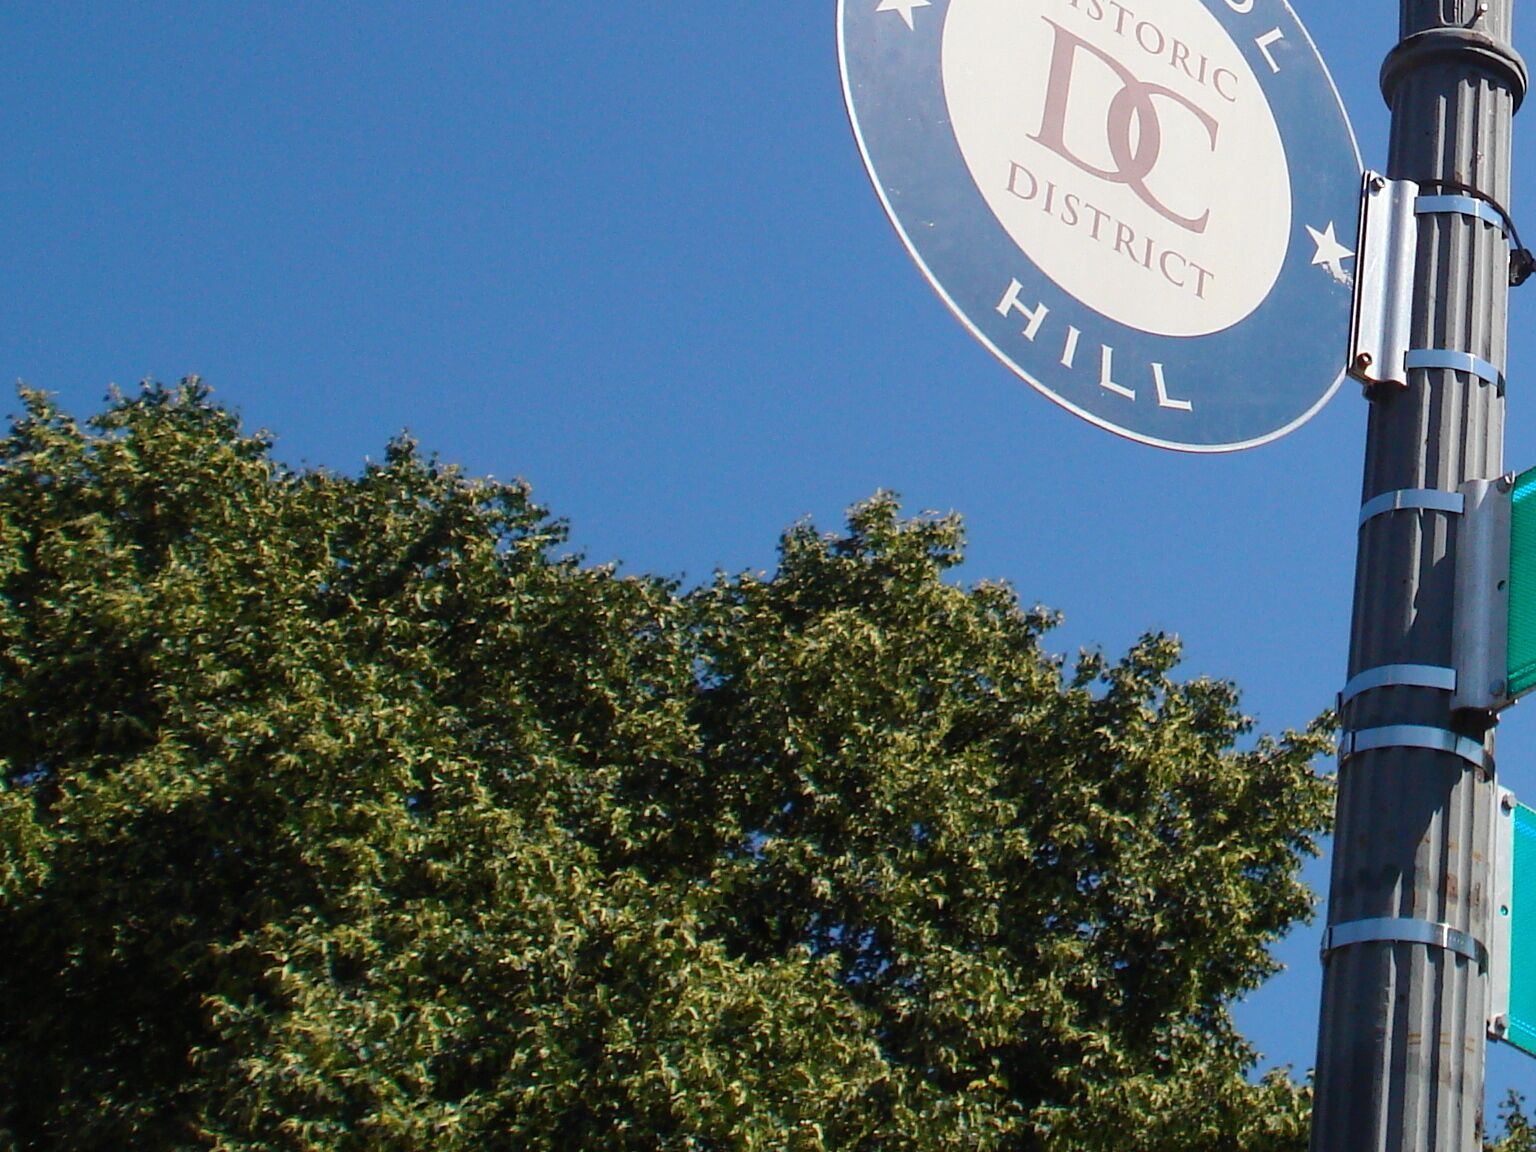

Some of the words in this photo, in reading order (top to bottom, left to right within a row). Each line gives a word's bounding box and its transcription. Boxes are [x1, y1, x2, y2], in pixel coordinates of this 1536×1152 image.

[1026, 16, 1218, 234] DC
[1004, 160, 1214, 300] DISTRICT
[996, 278, 1193, 411] HILL
